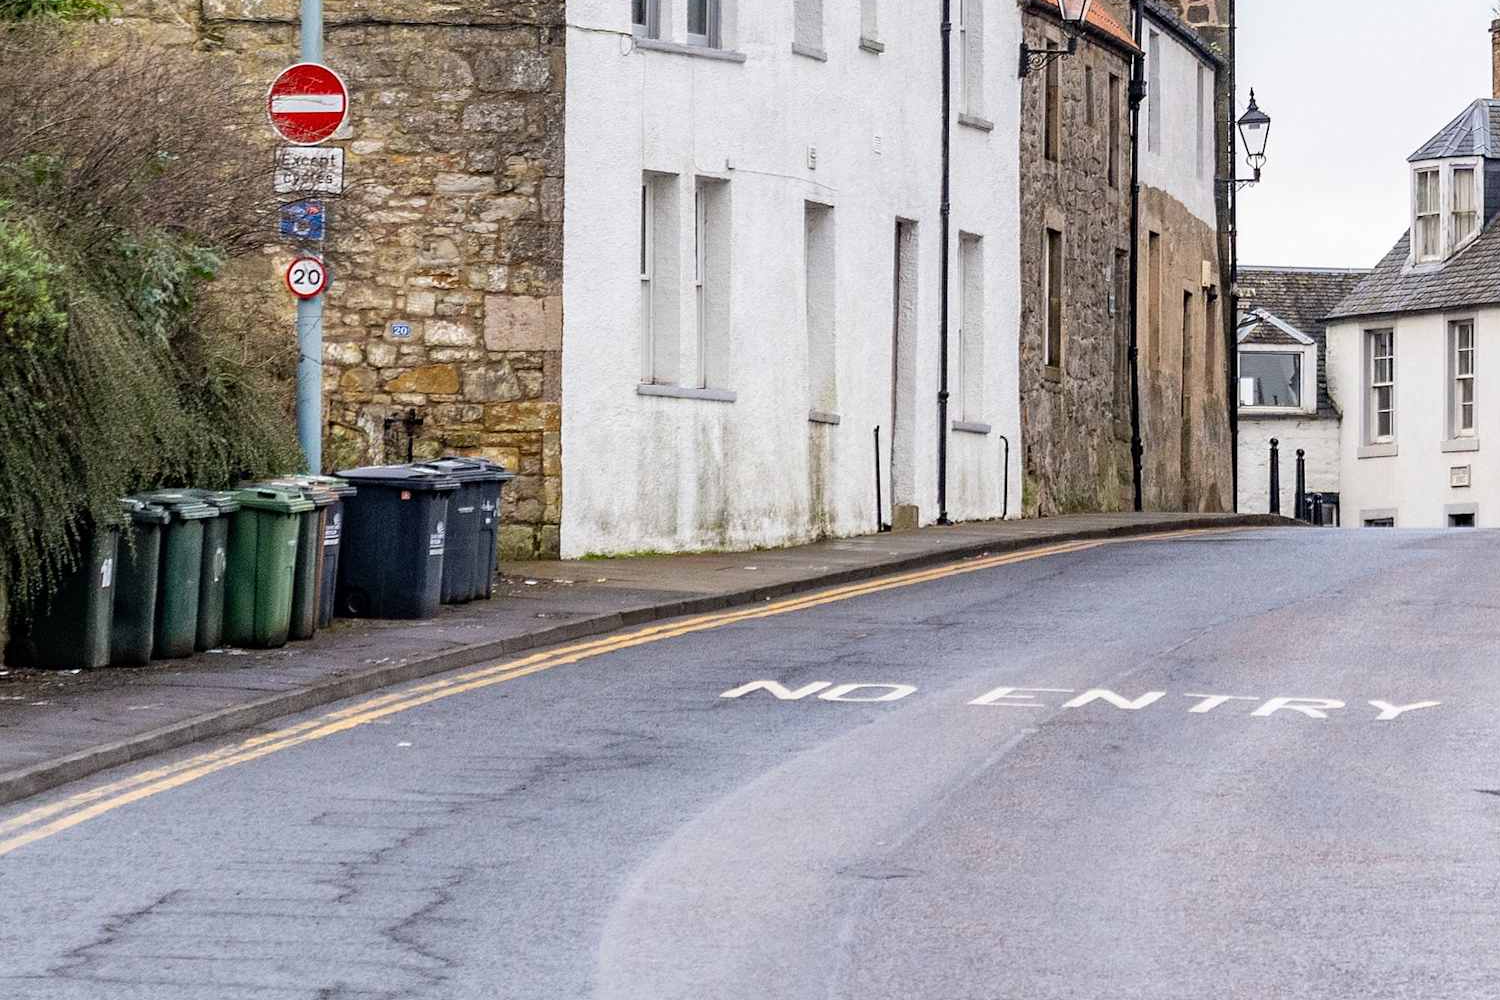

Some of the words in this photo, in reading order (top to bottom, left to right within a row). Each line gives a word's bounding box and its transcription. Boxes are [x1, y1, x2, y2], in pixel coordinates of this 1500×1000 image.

[293, 269, 321, 286] 20
[393, 326, 408, 336] 20
[719, 680, 918, 703] NO
[965, 685, 1443, 721] ENTRY
